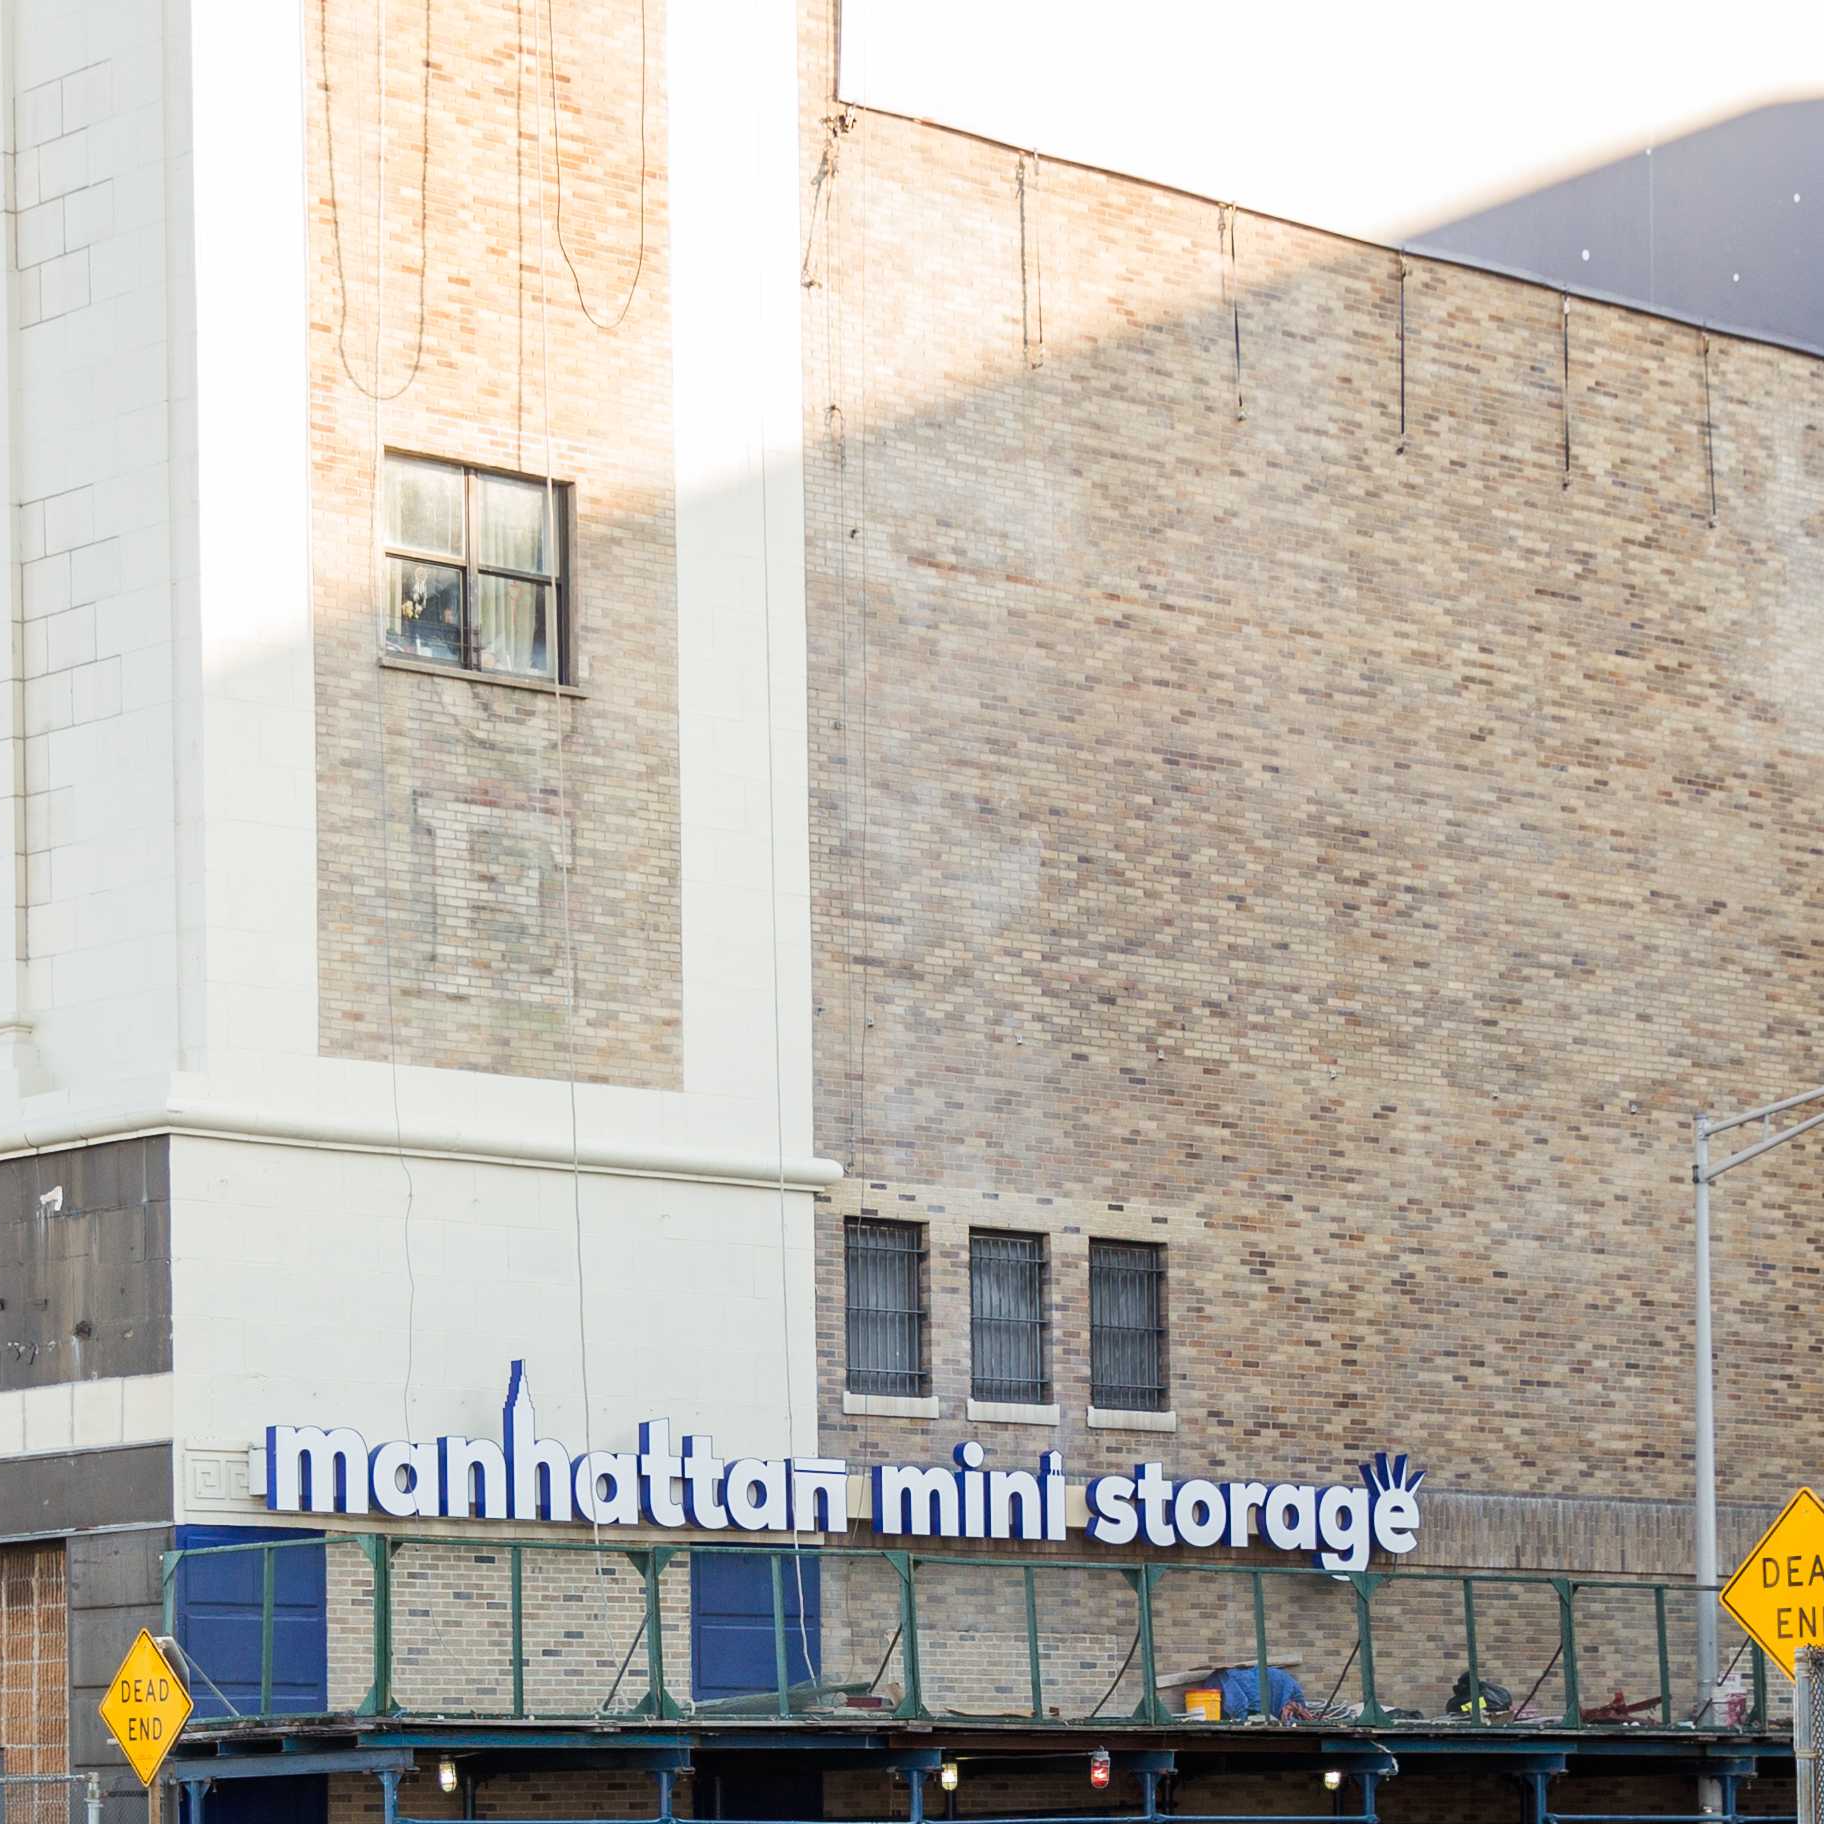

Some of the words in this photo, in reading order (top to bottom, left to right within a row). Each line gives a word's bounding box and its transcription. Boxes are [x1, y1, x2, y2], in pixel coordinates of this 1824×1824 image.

[266, 1358, 849, 1534] manhattan
[872, 1440, 1067, 1542] mini
[1085, 1450, 1427, 1582] storage
[121, 1679, 170, 1704] DEAD
[128, 1716, 163, 1742] END
